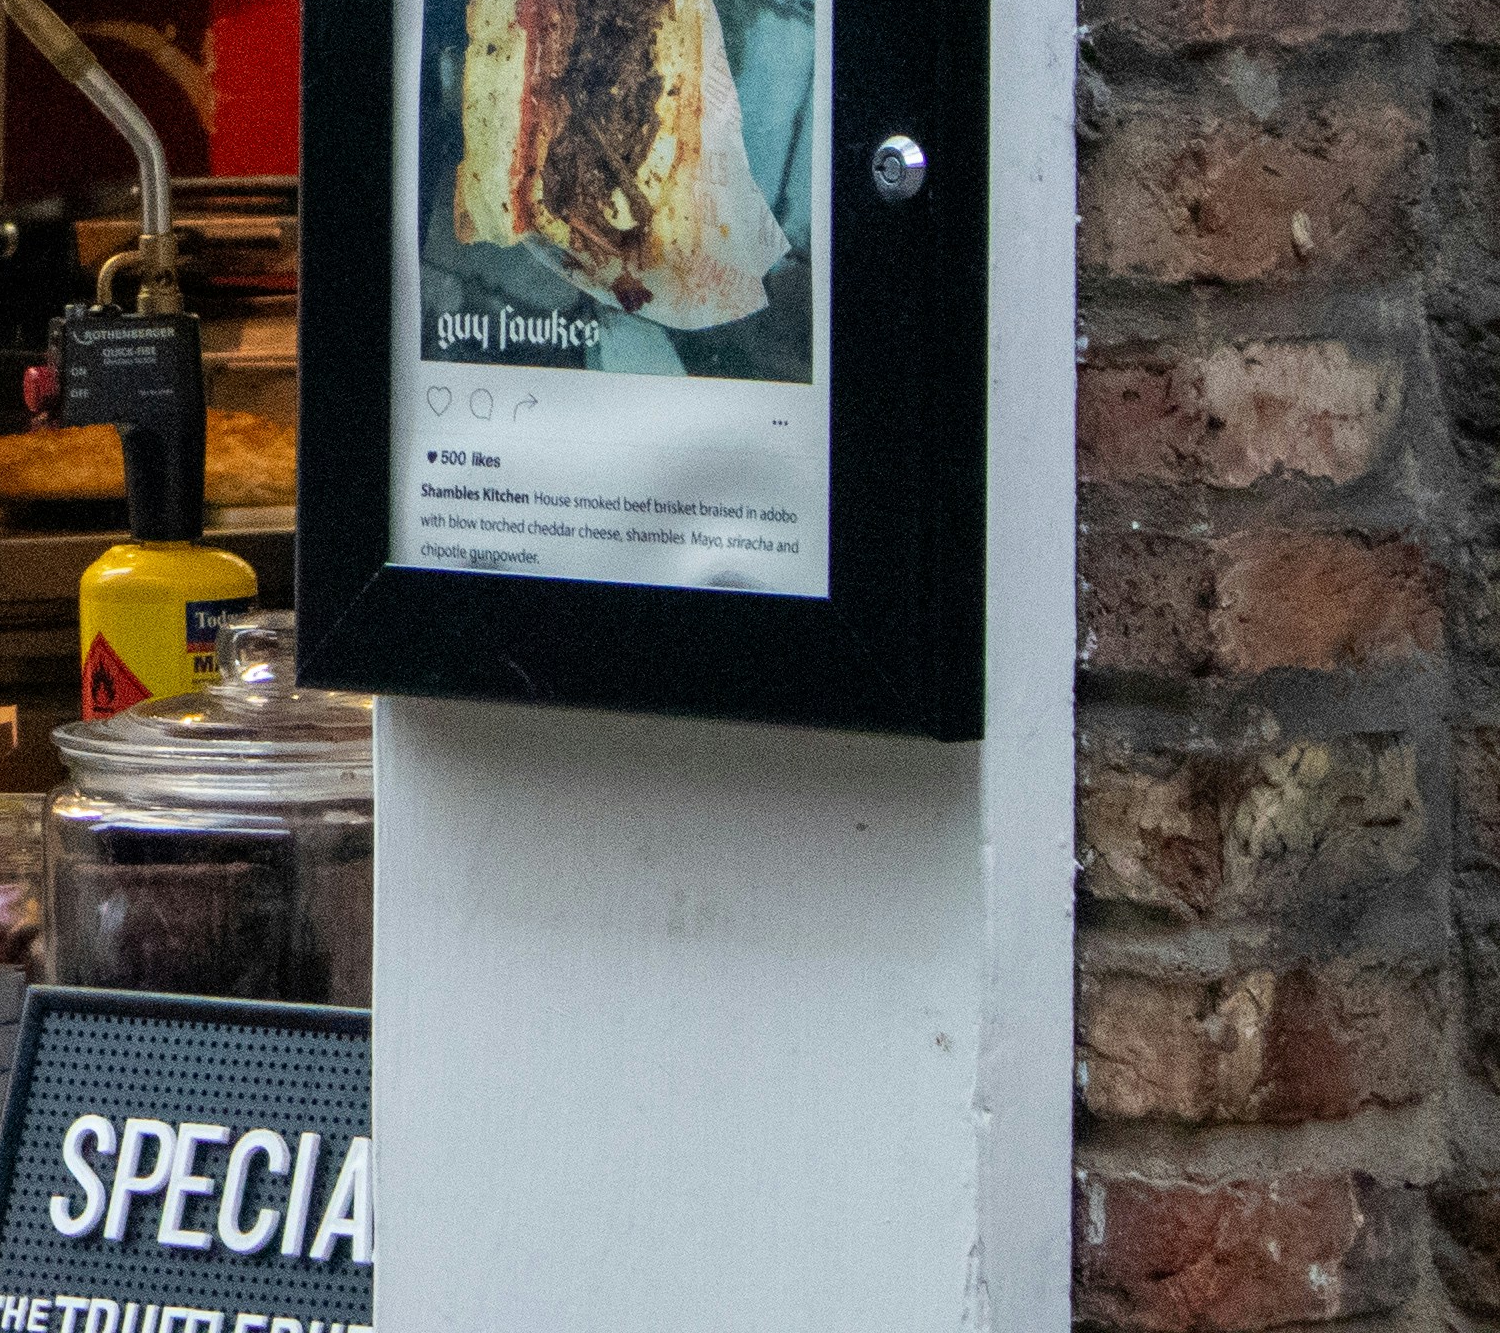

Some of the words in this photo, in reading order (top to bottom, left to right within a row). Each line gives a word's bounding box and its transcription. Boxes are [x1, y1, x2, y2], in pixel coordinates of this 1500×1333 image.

[438, 312, 489, 350] guy
[500, 305, 600, 351] fawkes
[441, 450, 466, 466] 500
[472, 451, 501, 468] likes
[421, 483, 480, 501] Shambles
[483, 487, 530, 504] Kitchen
[534, 491, 571, 508] House
[574, 495, 620, 512] smoked
[623, 497, 652, 513] beef
[654, 499, 697, 516] brisket
[700, 503, 743, 519] braised
[746, 505, 757, 520] in
[760, 507, 798, 524] adobo
[421, 513, 446, 528] with
[449, 514, 476, 530] blow
[480, 517, 525, 533] torched
[528, 520, 575, 537] cheddar
[626, 528, 685, 545] shambles
[727, 536, 774, 552] sriracha
[777, 540, 799, 554] and
[421, 543, 467, 560] chipotle
[49, 1114, 374, 1266] SPECIA
